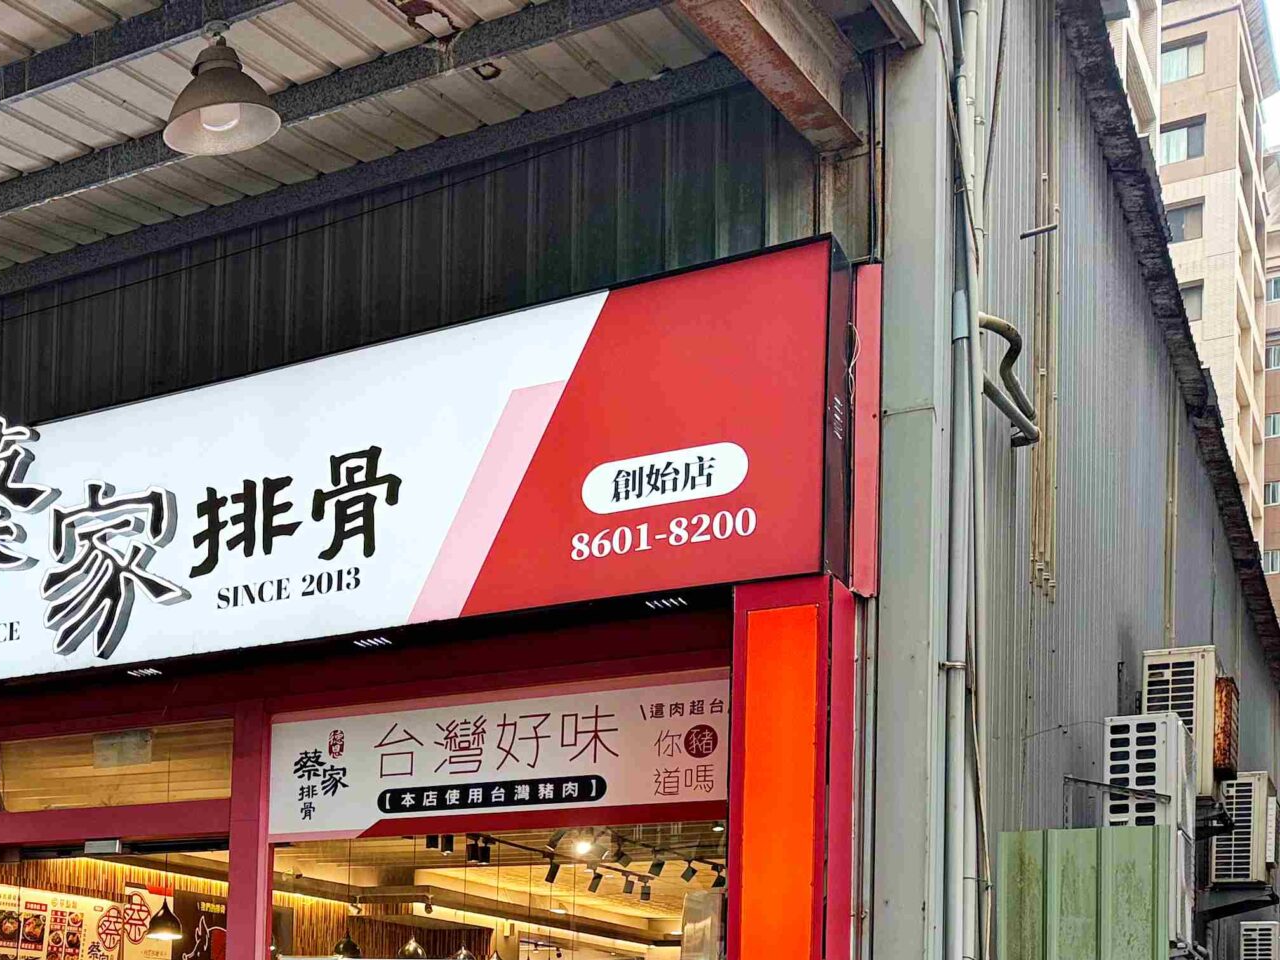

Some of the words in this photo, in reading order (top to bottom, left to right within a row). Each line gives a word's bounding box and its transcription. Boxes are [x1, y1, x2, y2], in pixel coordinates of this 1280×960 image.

[611, 455, 716, 503] 創始店
[570, 507, 757, 561] 8601-8200
[216, 577, 290, 609] SINCE
[301, 567, 361, 597] 2013
[374, 704, 620, 779] 台灣好味
